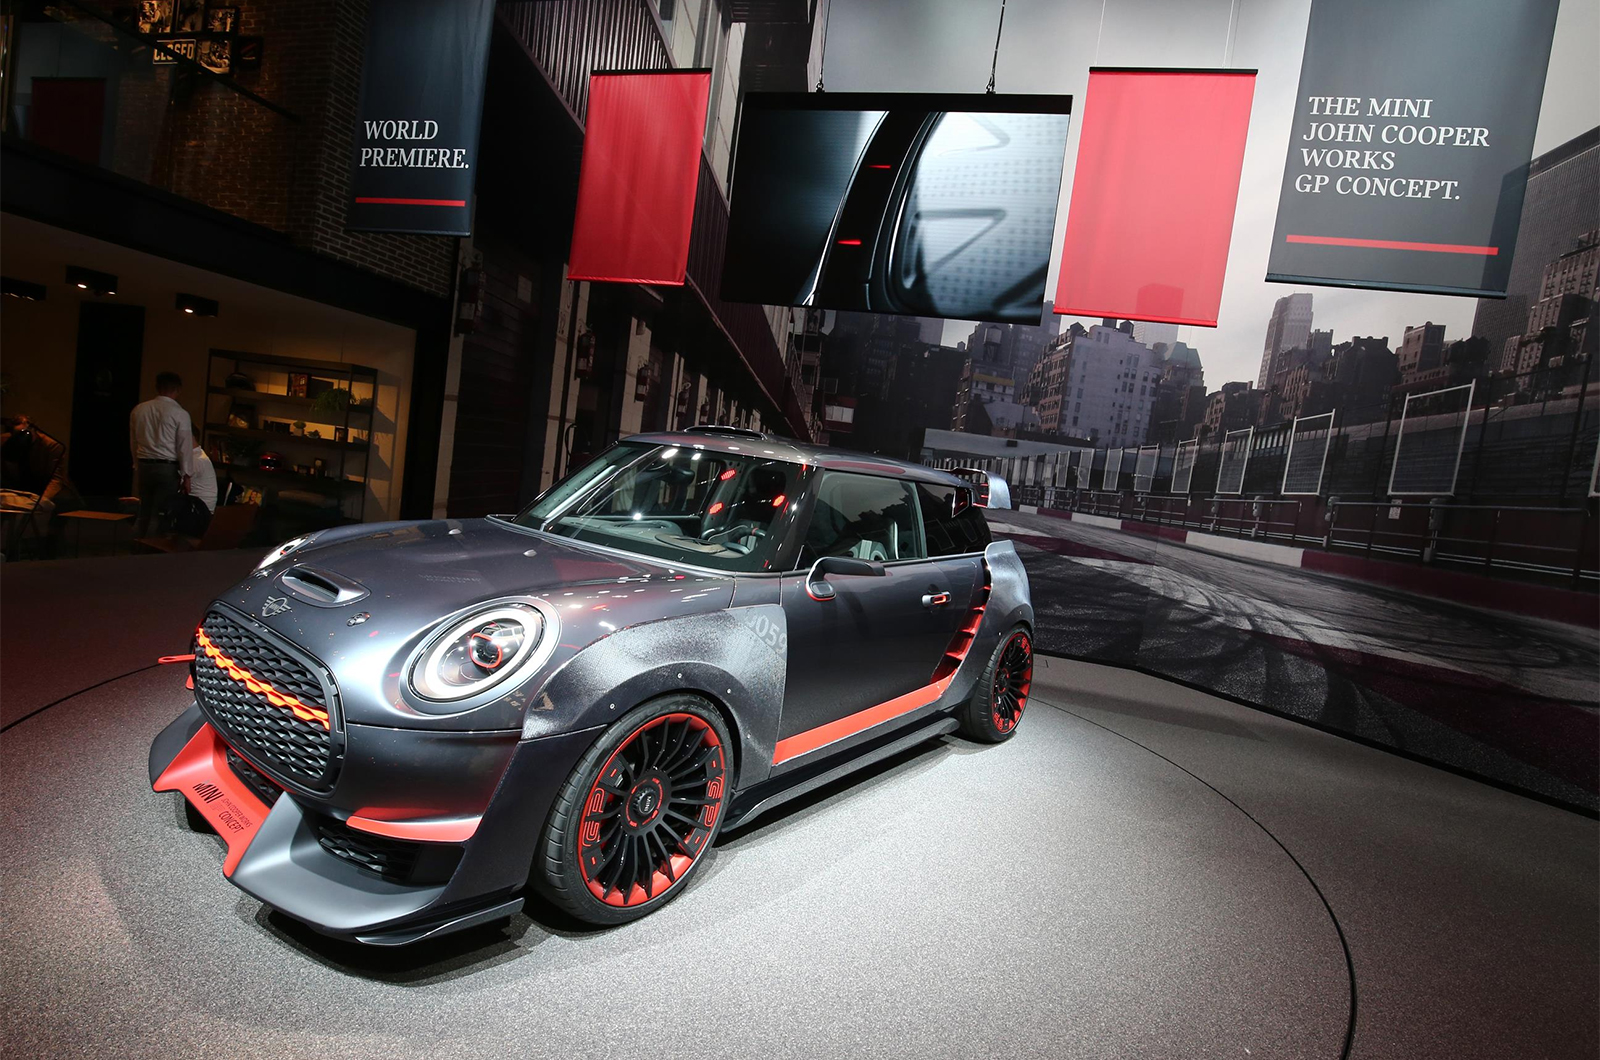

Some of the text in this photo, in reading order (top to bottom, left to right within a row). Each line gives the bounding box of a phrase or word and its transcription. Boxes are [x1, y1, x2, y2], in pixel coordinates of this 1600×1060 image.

[1308, 96, 1433, 118] THE MINI
[363, 119, 439, 140] WORLD
[1302, 122, 1490, 147] JOHN COOPER
[359, 147, 470, 169] PREMIERE.
[1300, 148, 1396, 170] WORKS
[1294, 173, 1461, 200] GP CONCEPT.
[192, 782, 224, 804] MINI
[218, 810, 244, 834] CONCEPT
